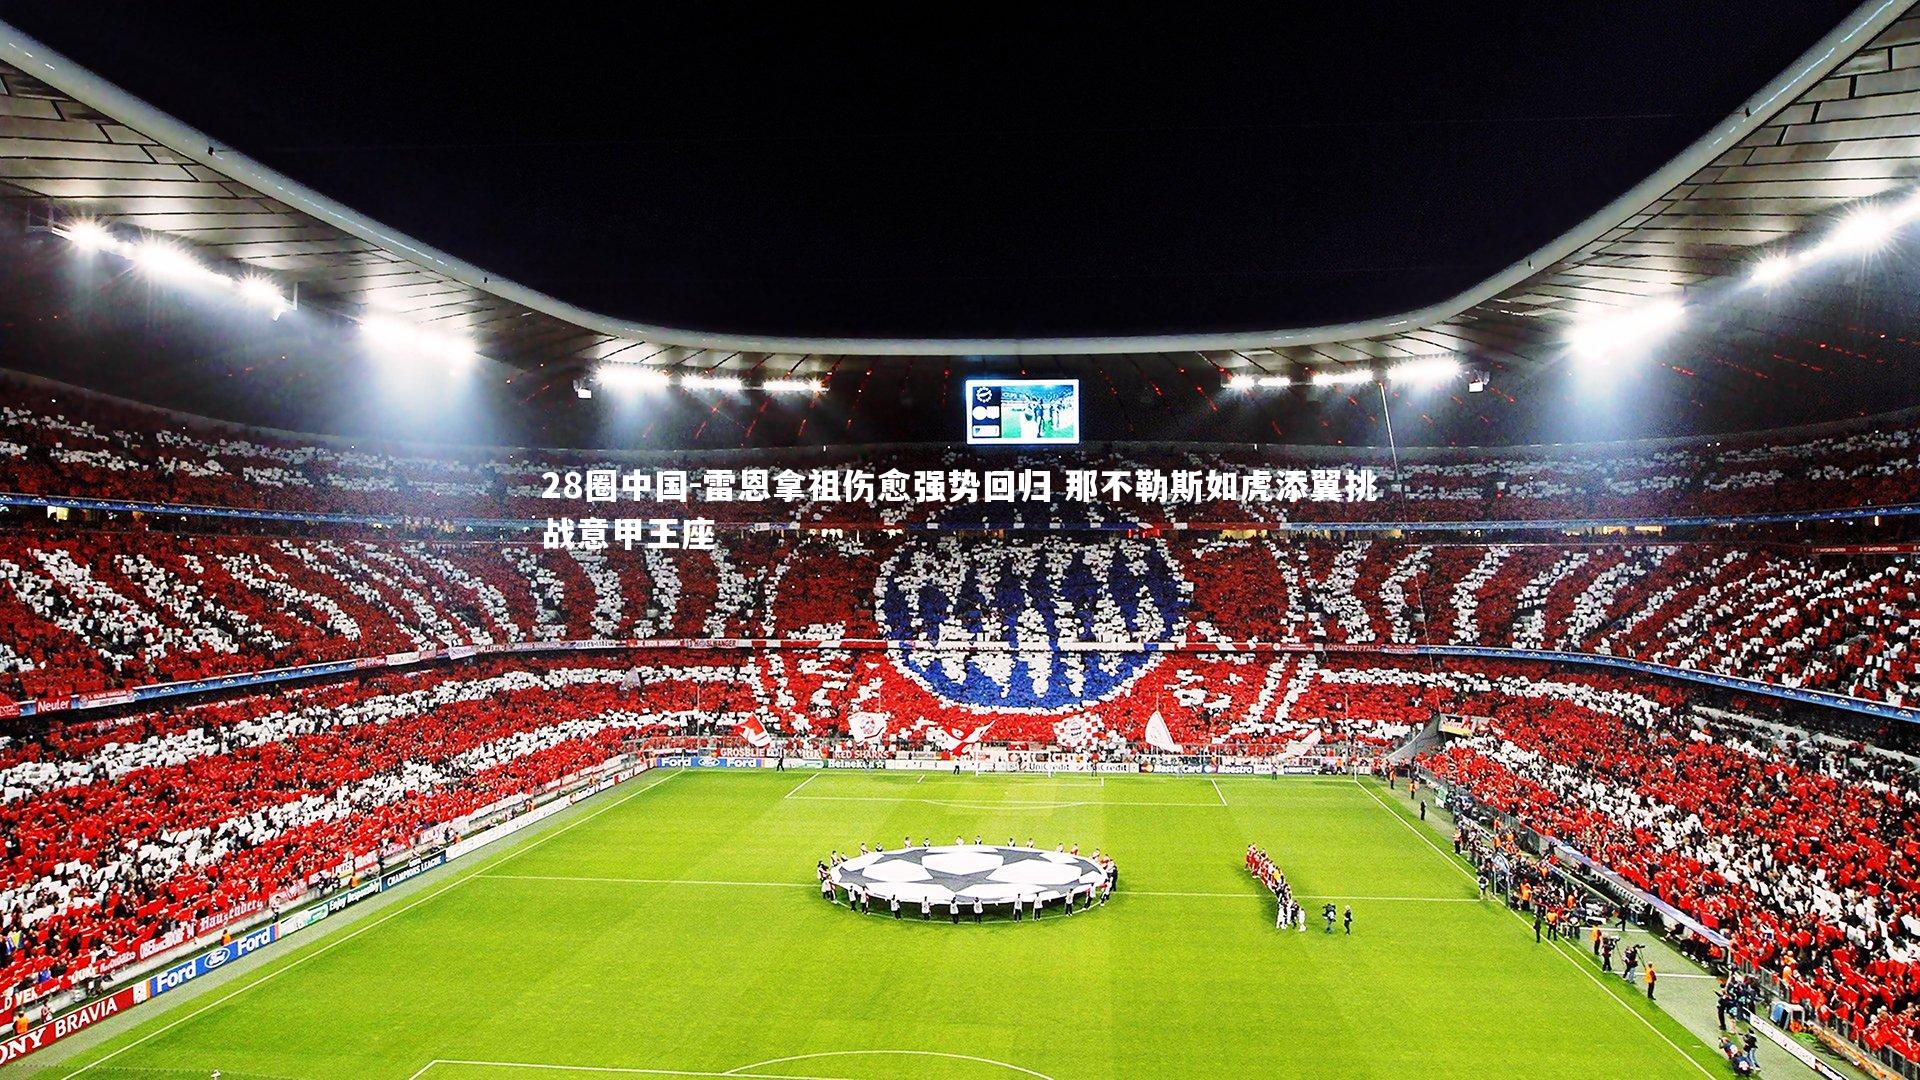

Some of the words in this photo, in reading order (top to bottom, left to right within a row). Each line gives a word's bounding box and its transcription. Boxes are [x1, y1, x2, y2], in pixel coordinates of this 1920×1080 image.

[661, 758, 691, 767] Ford
[726, 758, 757, 768] Ford
[237, 929, 271, 957] Ford
[157, 960, 197, 993] Ford
[0, 1027, 46, 1065] ONY
[55, 997, 118, 1038] BRAVIA
